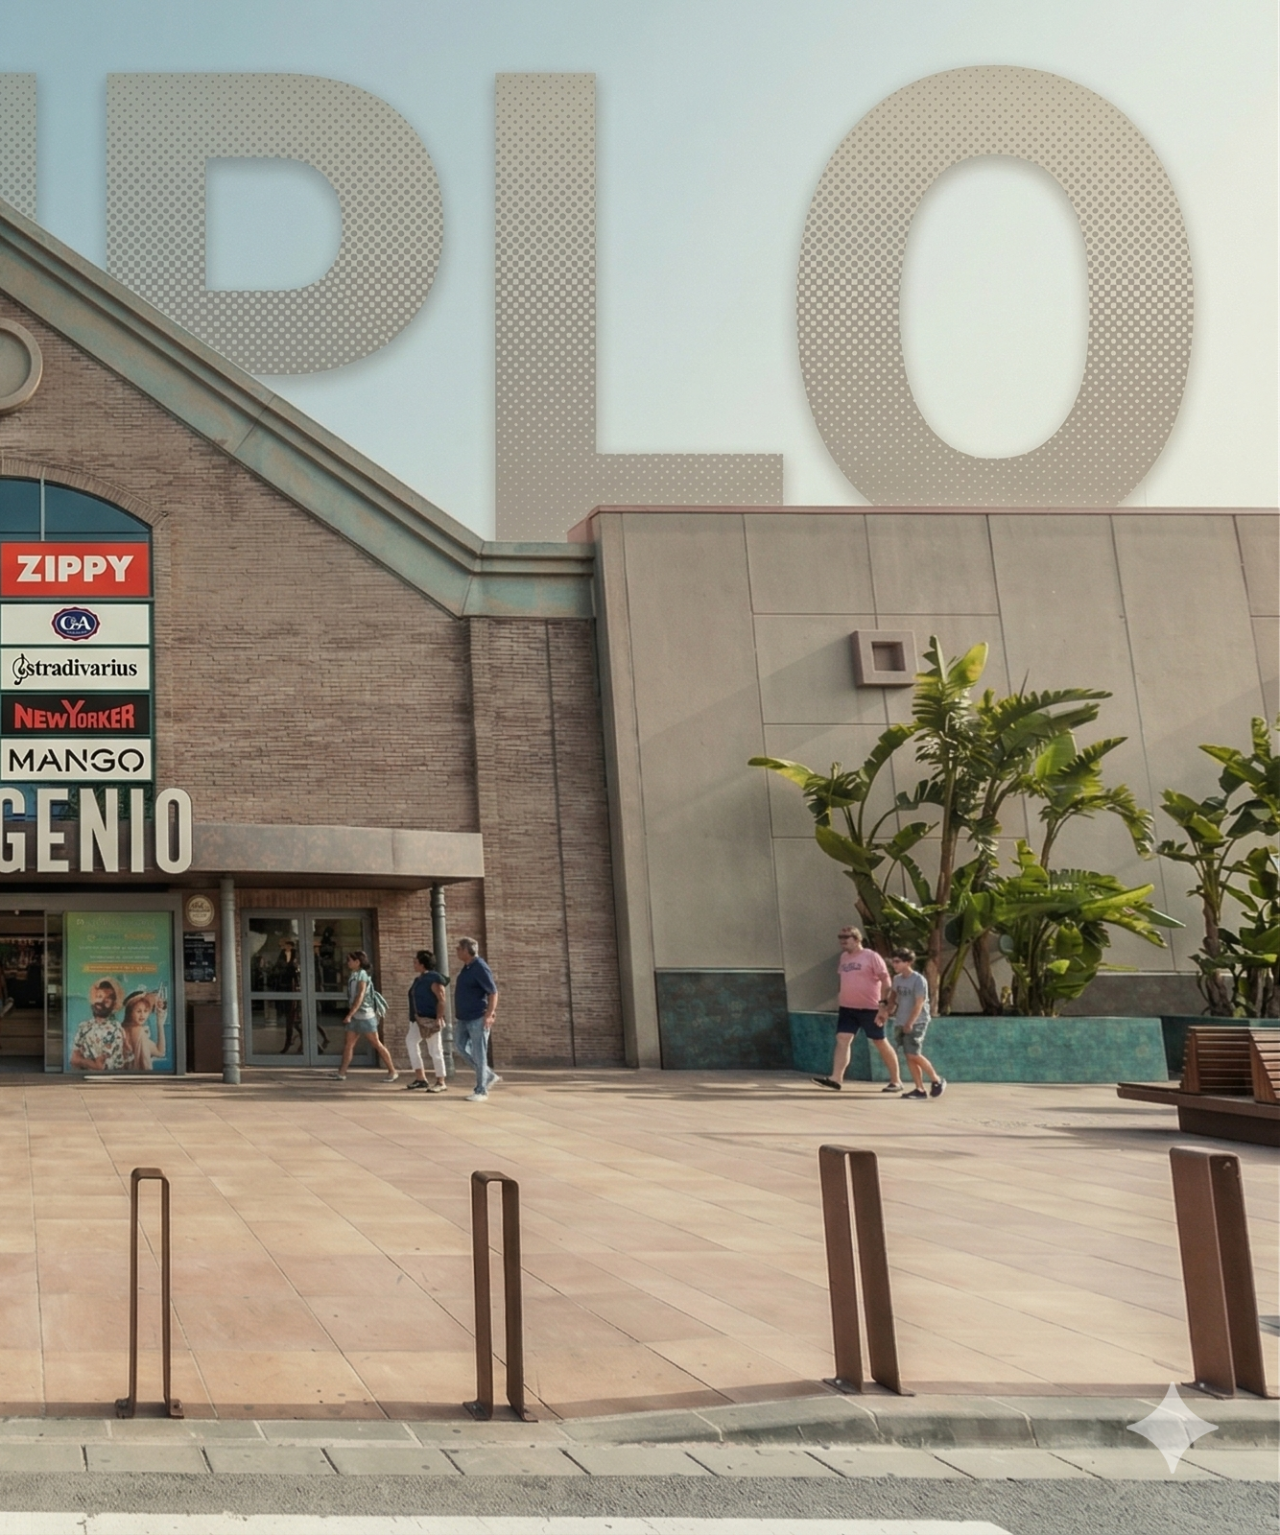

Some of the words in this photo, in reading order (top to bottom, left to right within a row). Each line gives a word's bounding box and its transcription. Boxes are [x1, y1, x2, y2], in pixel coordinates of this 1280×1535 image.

[16, 555, 134, 582] ZIPPY
[60, 616, 92, 630] C&A
[26, 658, 138, 676] stradivarius
[9, 748, 145, 772] MANGO
